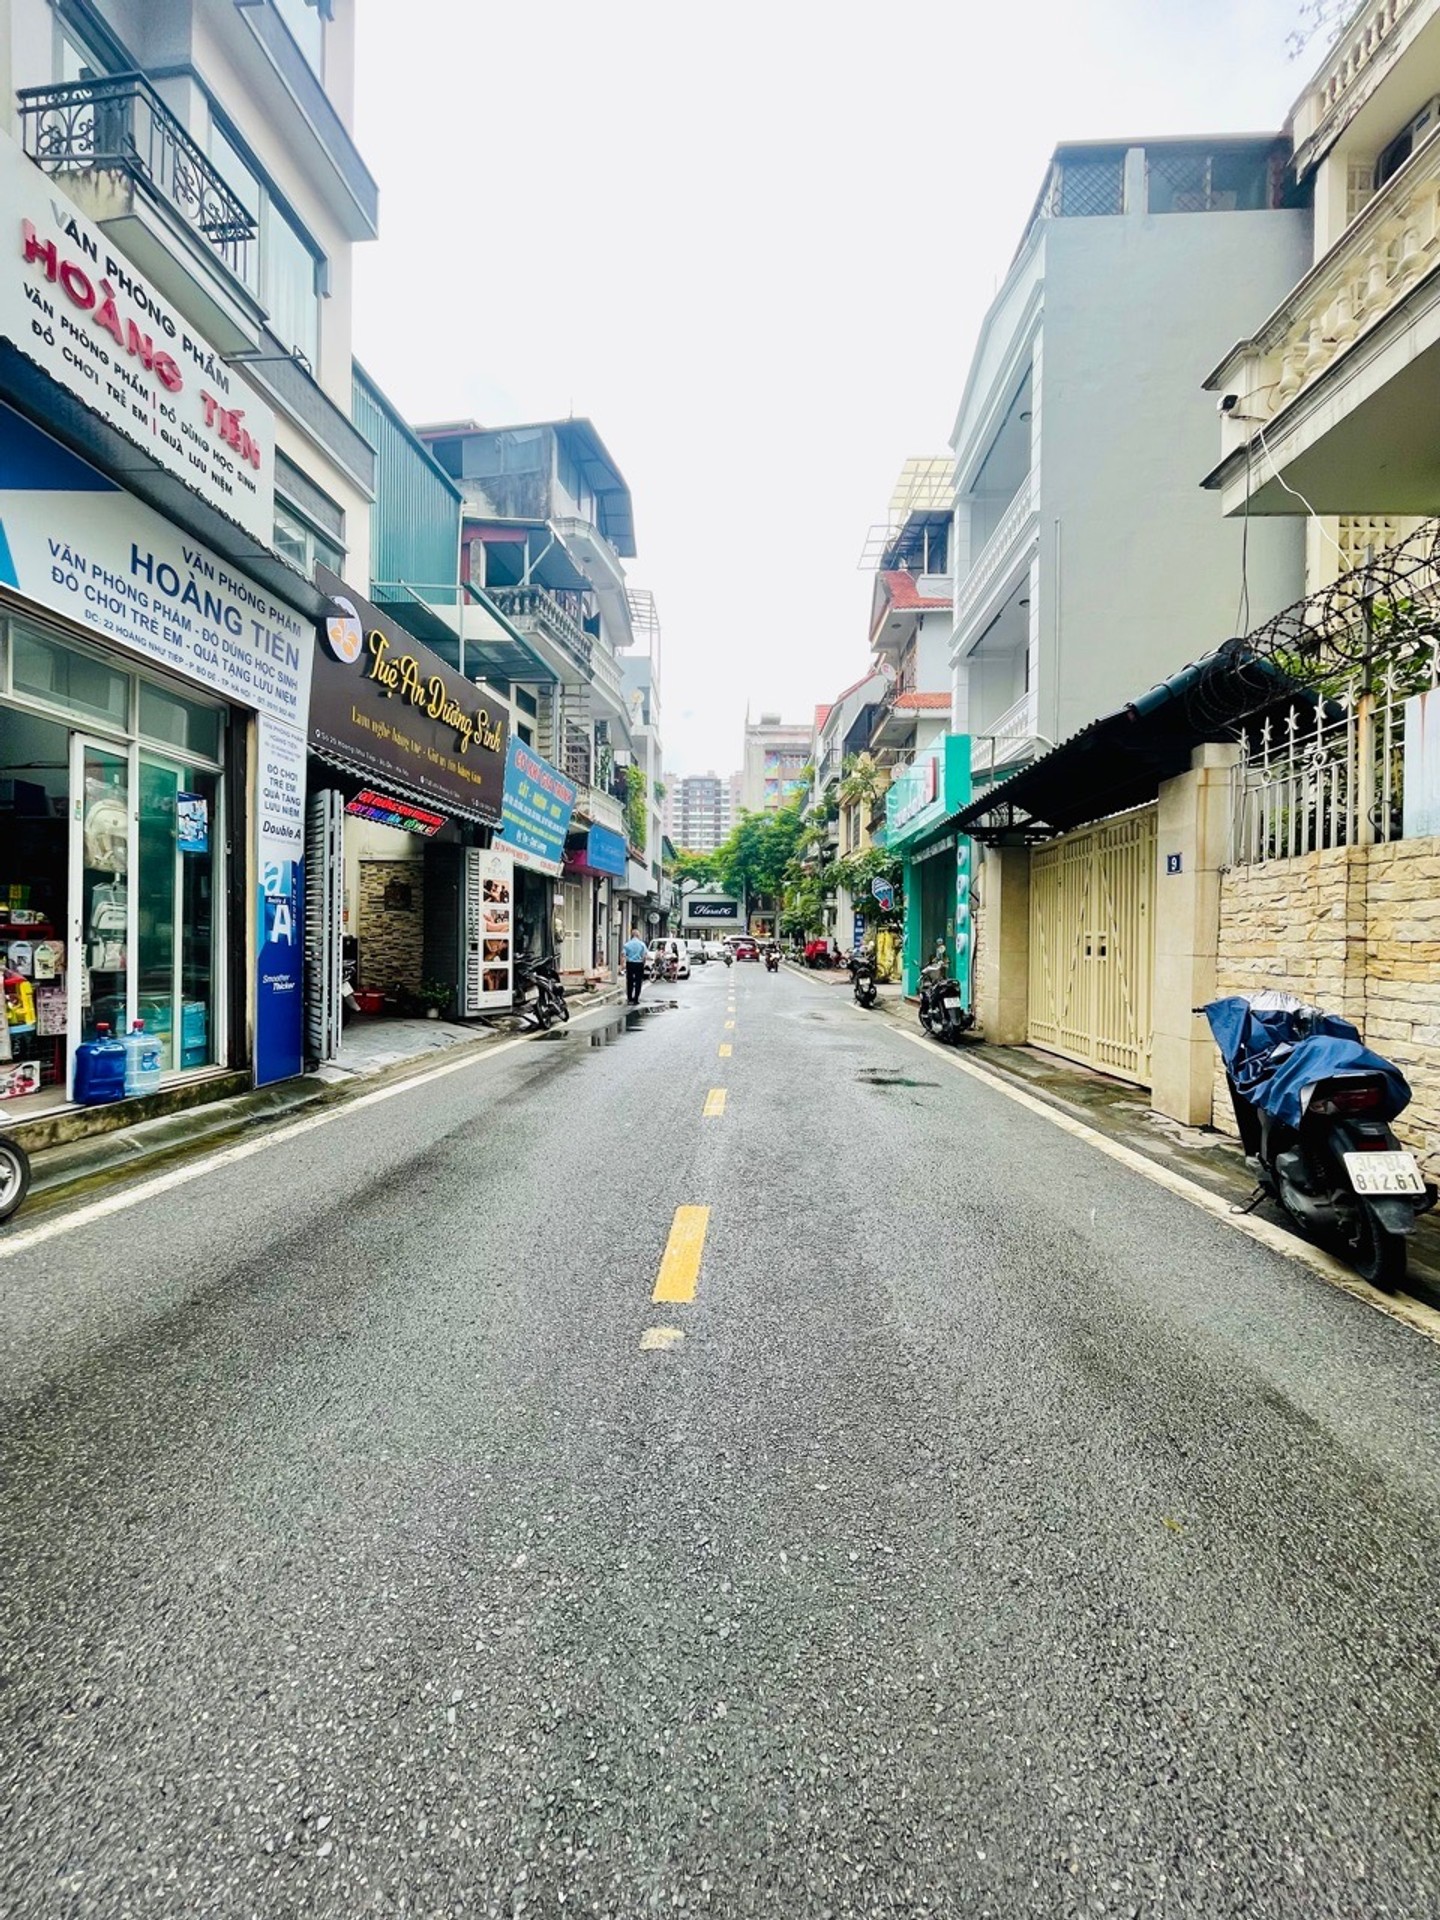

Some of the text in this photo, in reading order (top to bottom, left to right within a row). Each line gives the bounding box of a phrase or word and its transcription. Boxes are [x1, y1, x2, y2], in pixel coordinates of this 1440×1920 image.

[22, 217, 261, 470] HOÀNG TIẾN
[50, 198, 230, 395] VĂN PHÒNG PHẨM
[23, 281, 257, 494] VĂN PHÒNG PHẨM ĐỒ DÙNG HỌC SINH
[31, 318, 233, 497] ĐỒ CHƠI TRẺ EM QUÀ LƯU NIỆM
[48, 537, 87, 574] VĂN
[92, 563, 149, 608] PHÒNG
[222, 640, 253, 667] DÙNG
[254, 657, 276, 679] HỌC
[277, 669, 298, 692] SINH
[103, 618, 115, 632] 22
[115, 624, 148, 647] HOÀNG
[131, 542, 243, 637] HOÀNG
[182, 546, 215, 581] VĂN
[218, 571, 267, 614] PHÒNG
[84, 584, 126, 618] CHƠI
[130, 607, 159, 636] TRẺ
[163, 626, 183, 648] EM
[193, 642, 220, 668] QUÀ
[222, 656, 251, 684] TẶNG
[253, 674, 274, 695] LƯU
[275, 685, 297, 707] NIỆM
[369, 629, 400, 699] Tuệ
[473, 708, 503, 754] Sinh
[263, 819, 302, 840] Double A
[1171, 856, 1178, 870] 9
[1356, 1173, 1419, 1191] 812.61
